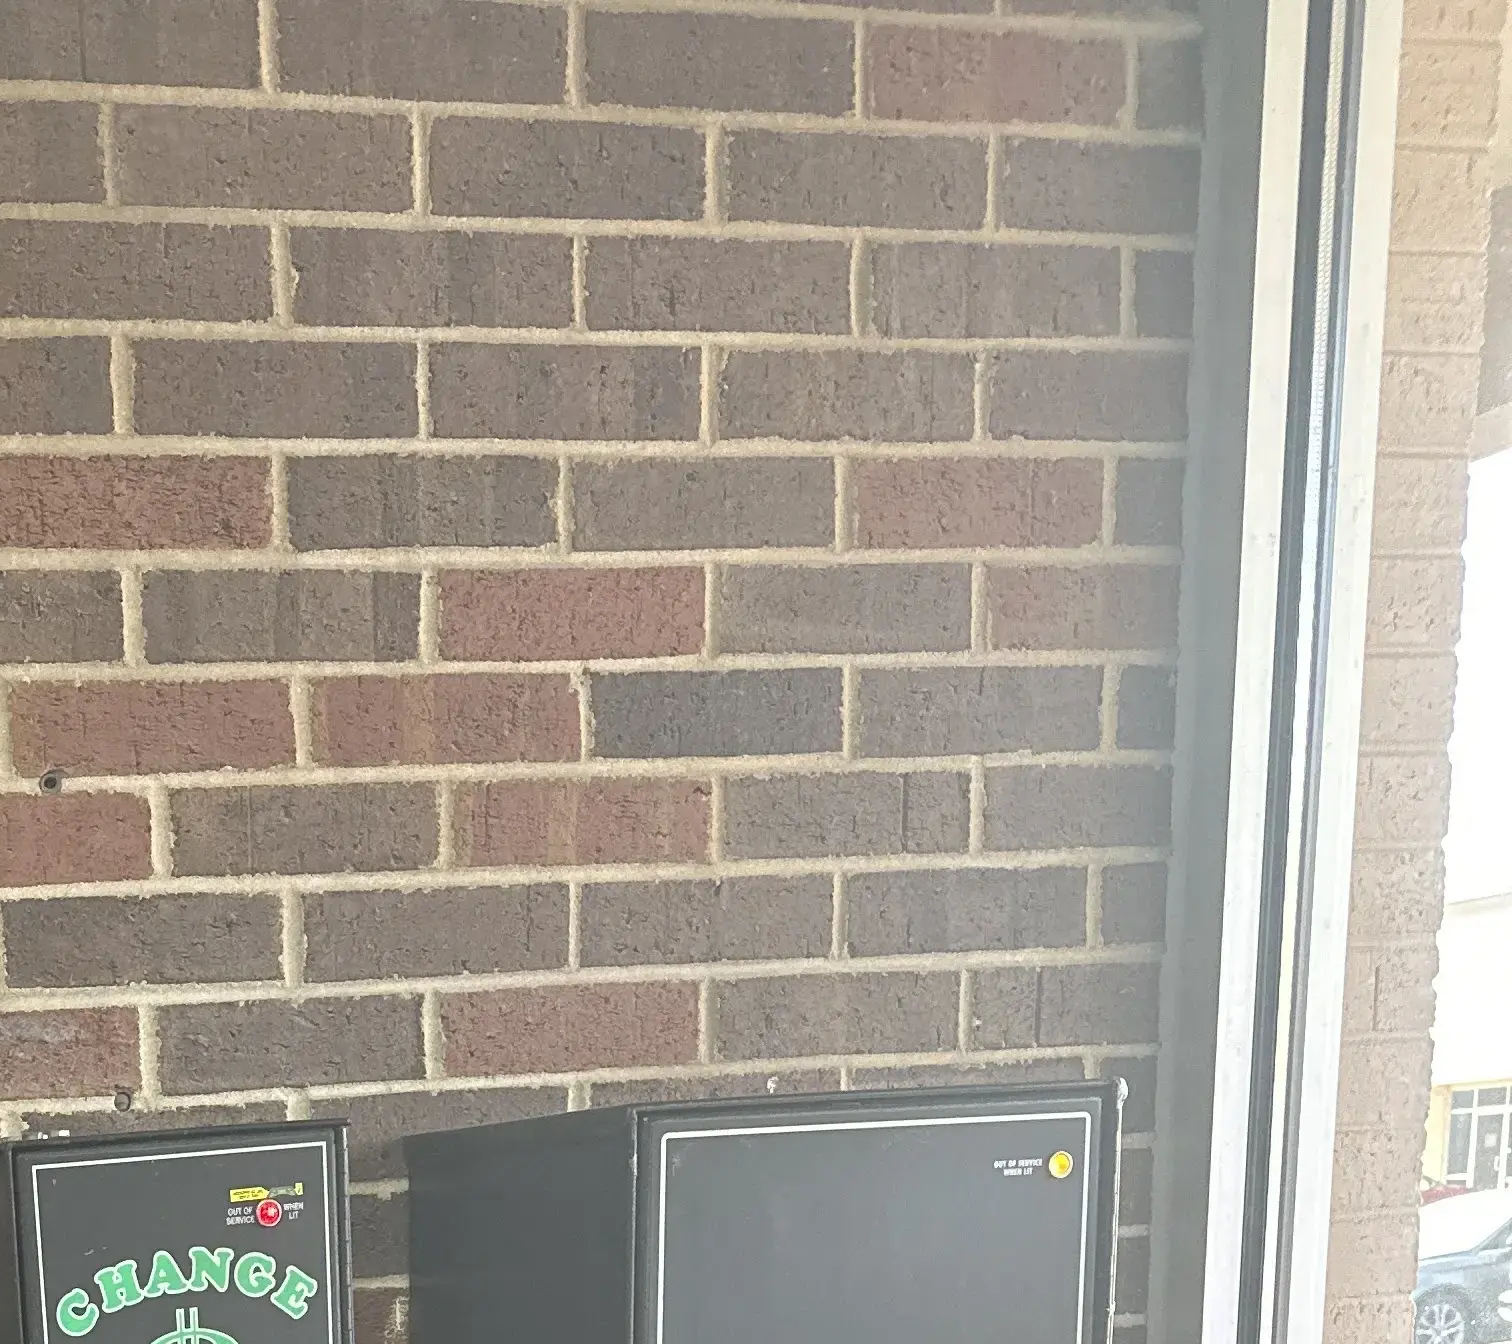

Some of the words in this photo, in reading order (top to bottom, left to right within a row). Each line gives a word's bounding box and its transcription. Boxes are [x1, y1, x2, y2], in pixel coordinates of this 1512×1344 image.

[227, 1207, 242, 1216] OUT
[243, 1206, 253, 1215] OF
[288, 1211, 299, 1220] LIT
[225, 1216, 255, 1226] SERVICE
[56, 1246, 318, 1336] CHANGE
